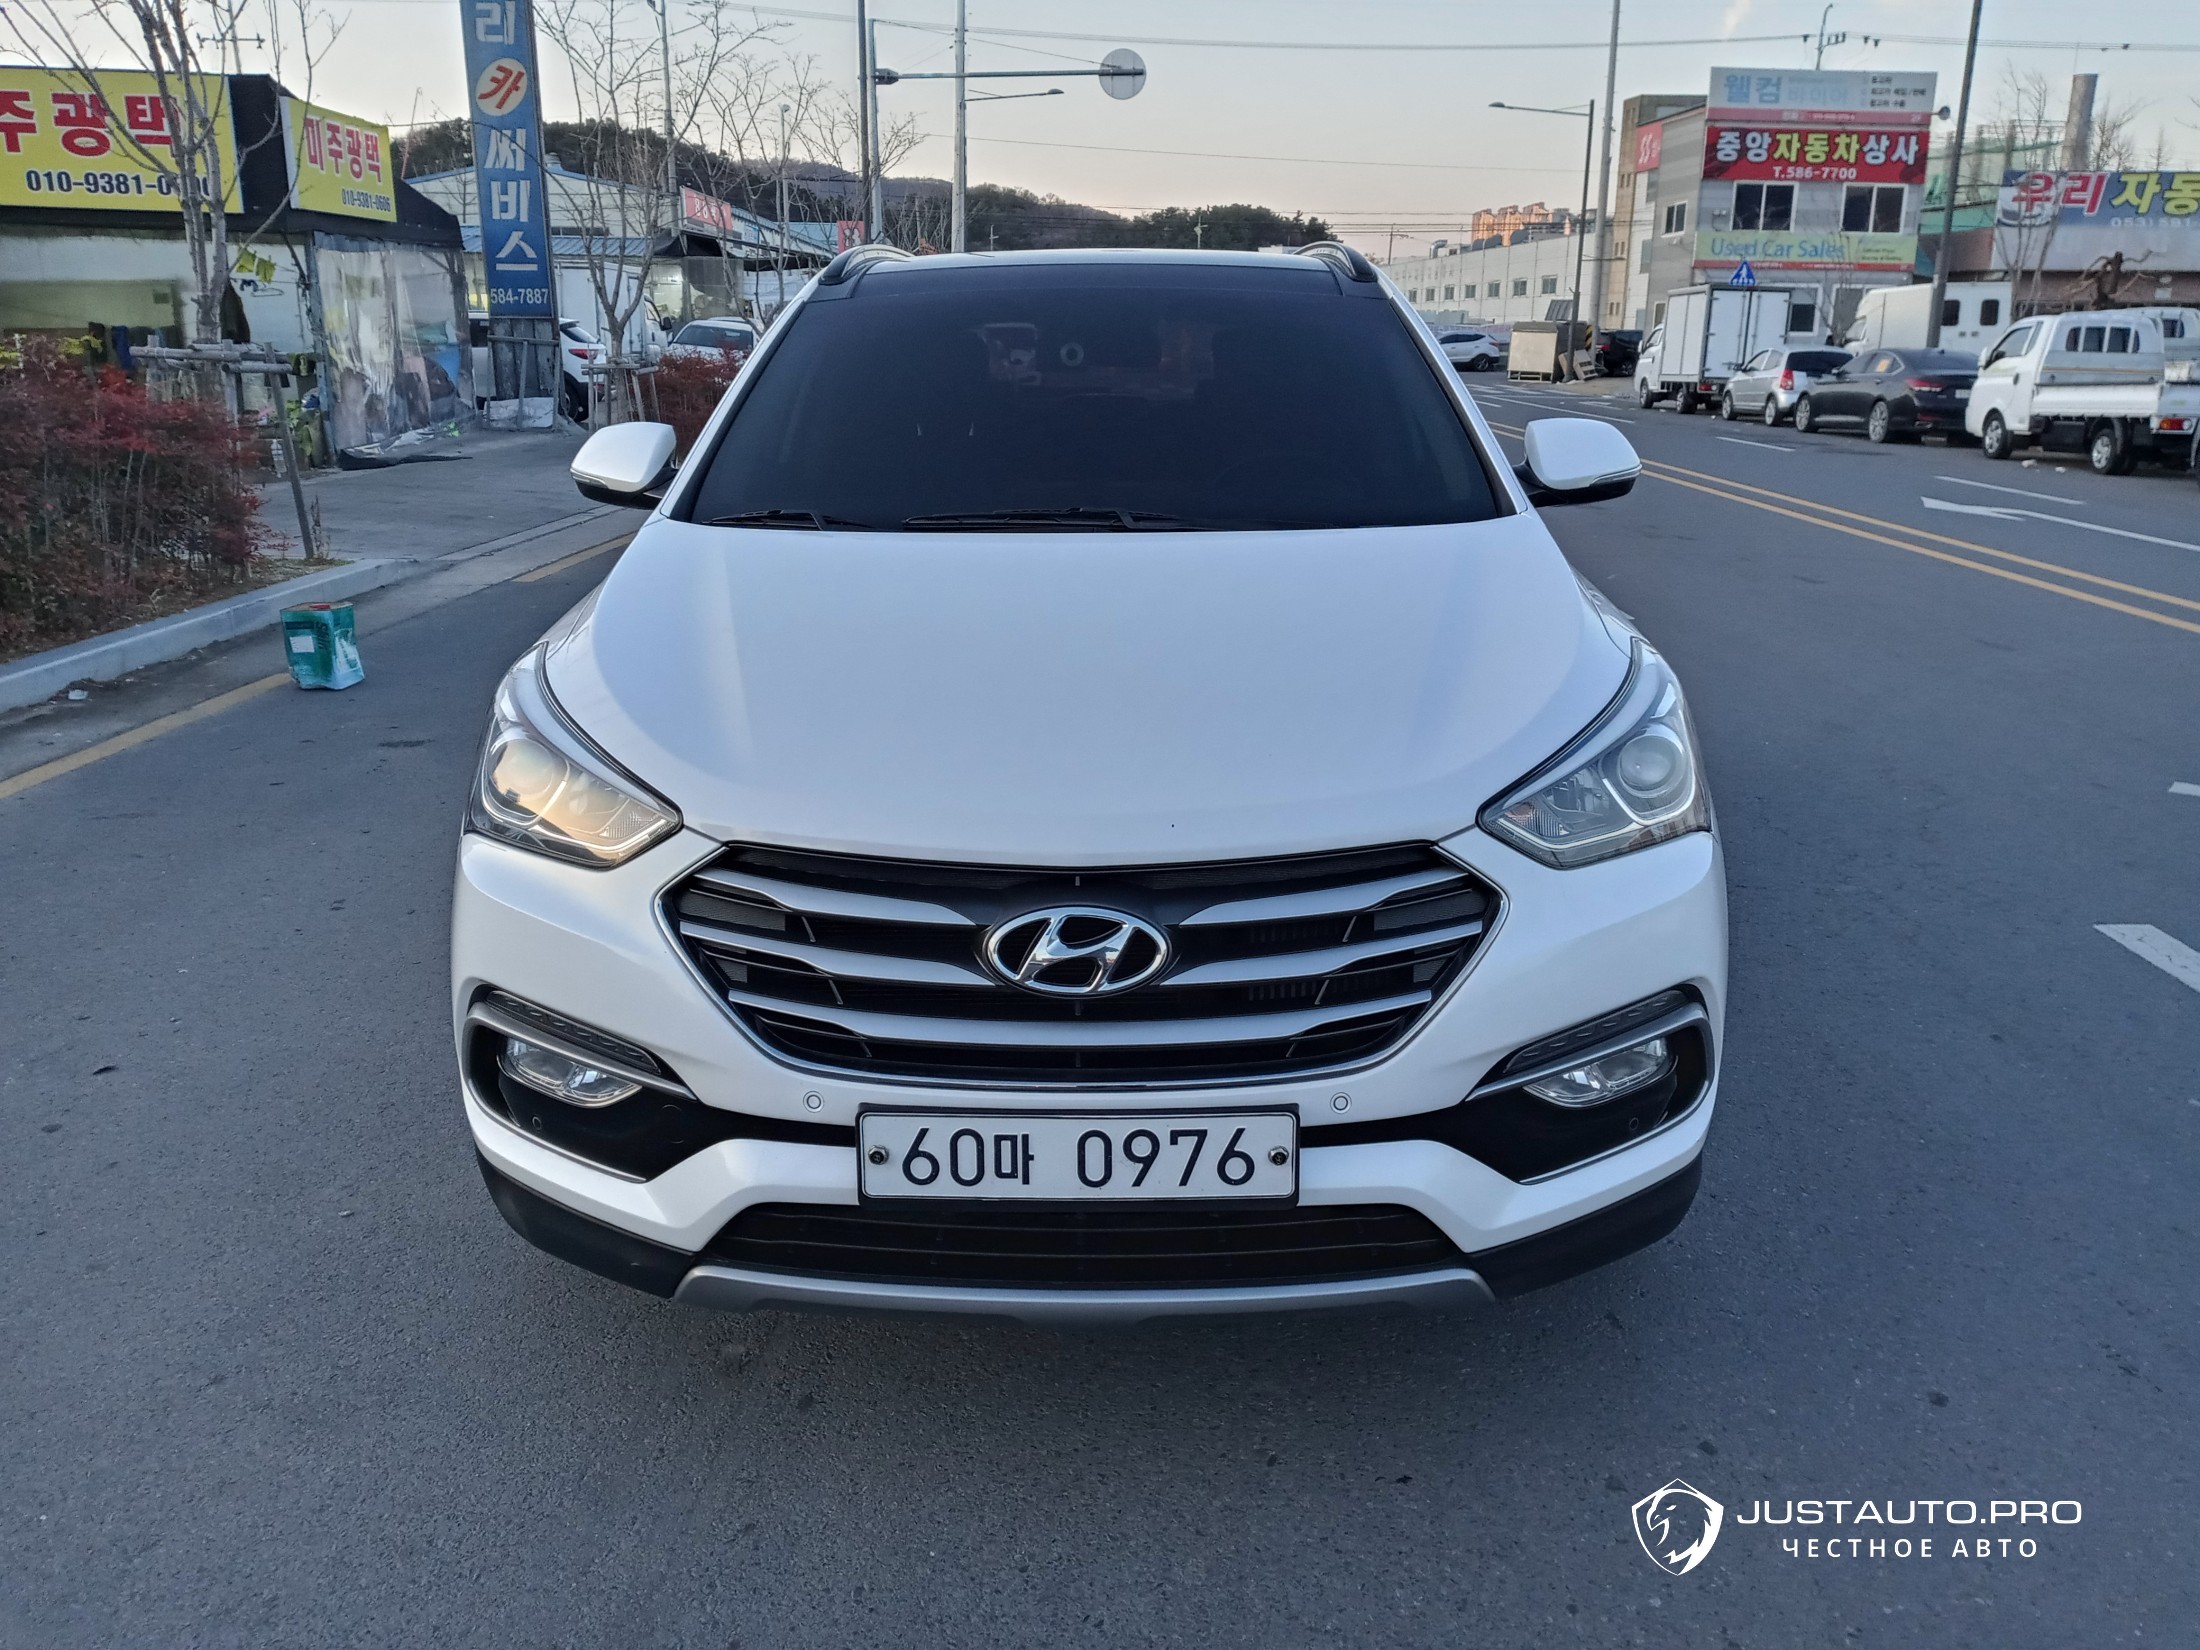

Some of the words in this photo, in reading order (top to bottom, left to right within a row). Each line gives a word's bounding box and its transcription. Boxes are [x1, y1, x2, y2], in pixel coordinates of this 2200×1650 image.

[304, 117, 382, 184] 미주광택
[1716, 130, 1919, 165] 중앙자동차상사
[1773, 166, 1857, 180] T.586-7700
[1711, 238, 1758, 257] Used
[1762, 239, 1793, 257] Car
[490, 288, 549, 305] 584-7887
[902, 1127, 1035, 1187] 60마
[1076, 1127, 1256, 1188] 0976
